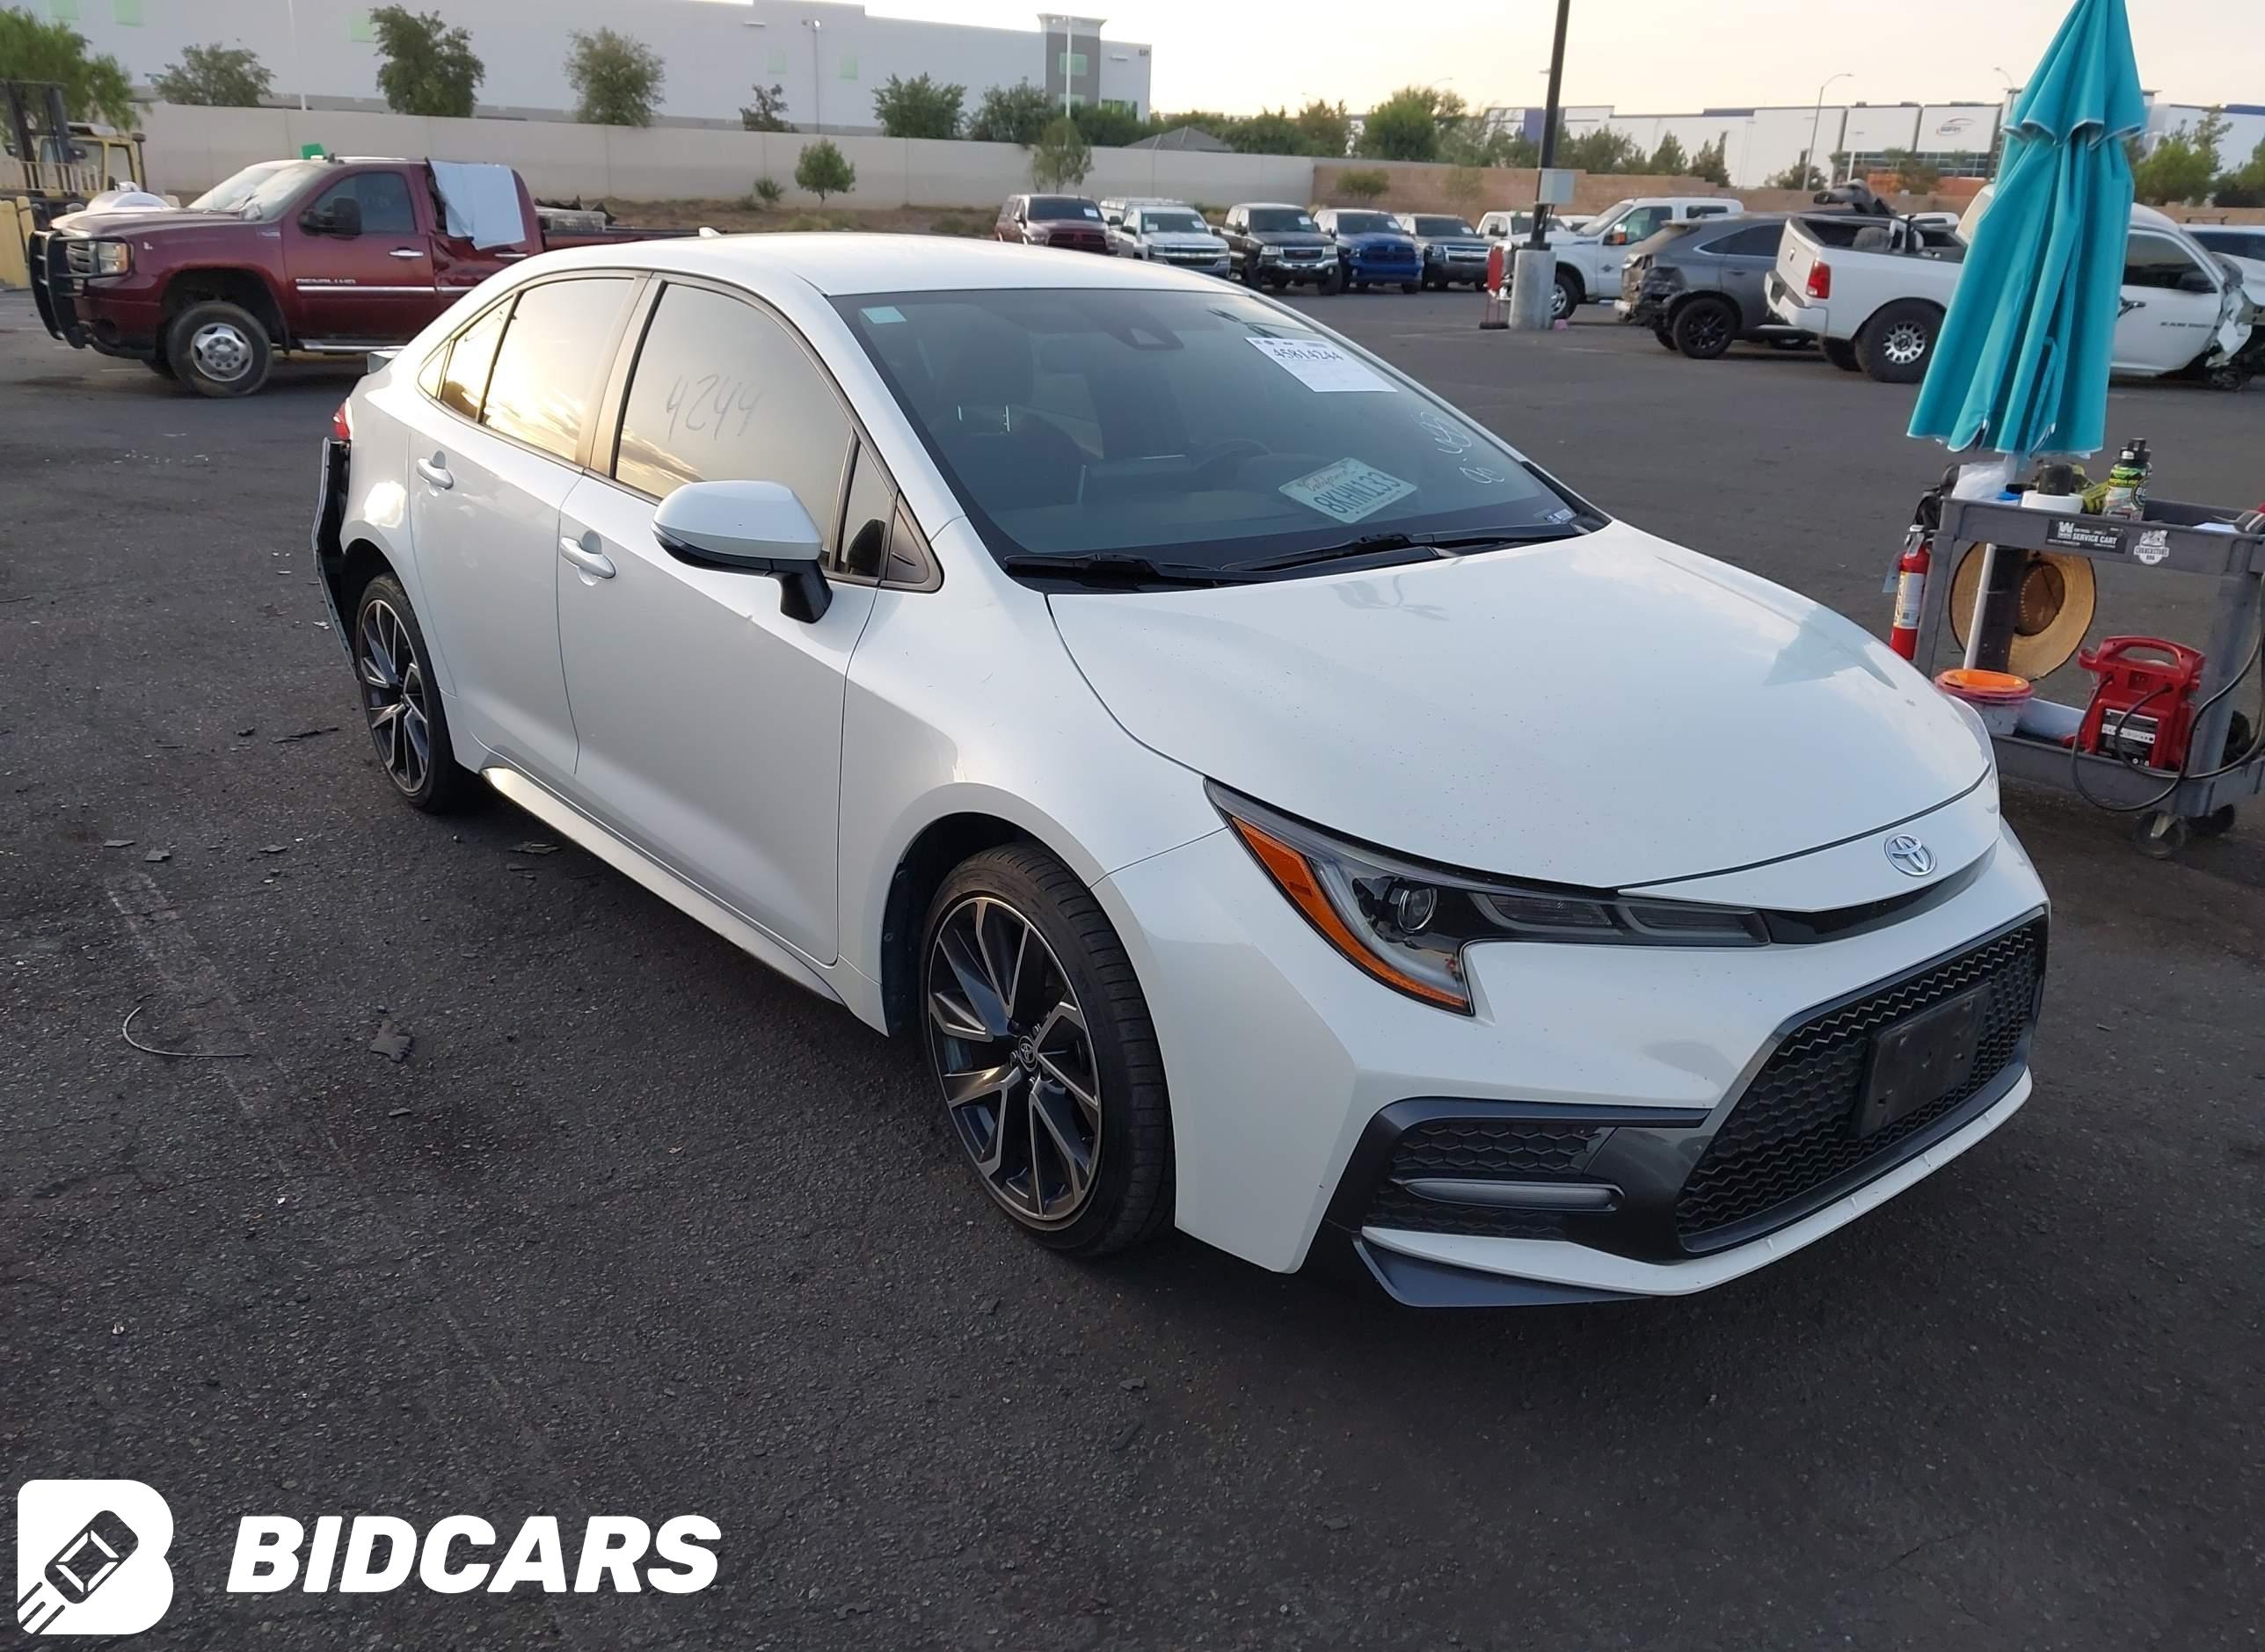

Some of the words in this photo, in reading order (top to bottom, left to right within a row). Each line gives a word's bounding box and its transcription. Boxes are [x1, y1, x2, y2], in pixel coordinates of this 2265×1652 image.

[1273, 348, 1344, 360] 45814244
[2072, 532, 2100, 542] SERVICE
[2100, 535, 2118, 544] CART
